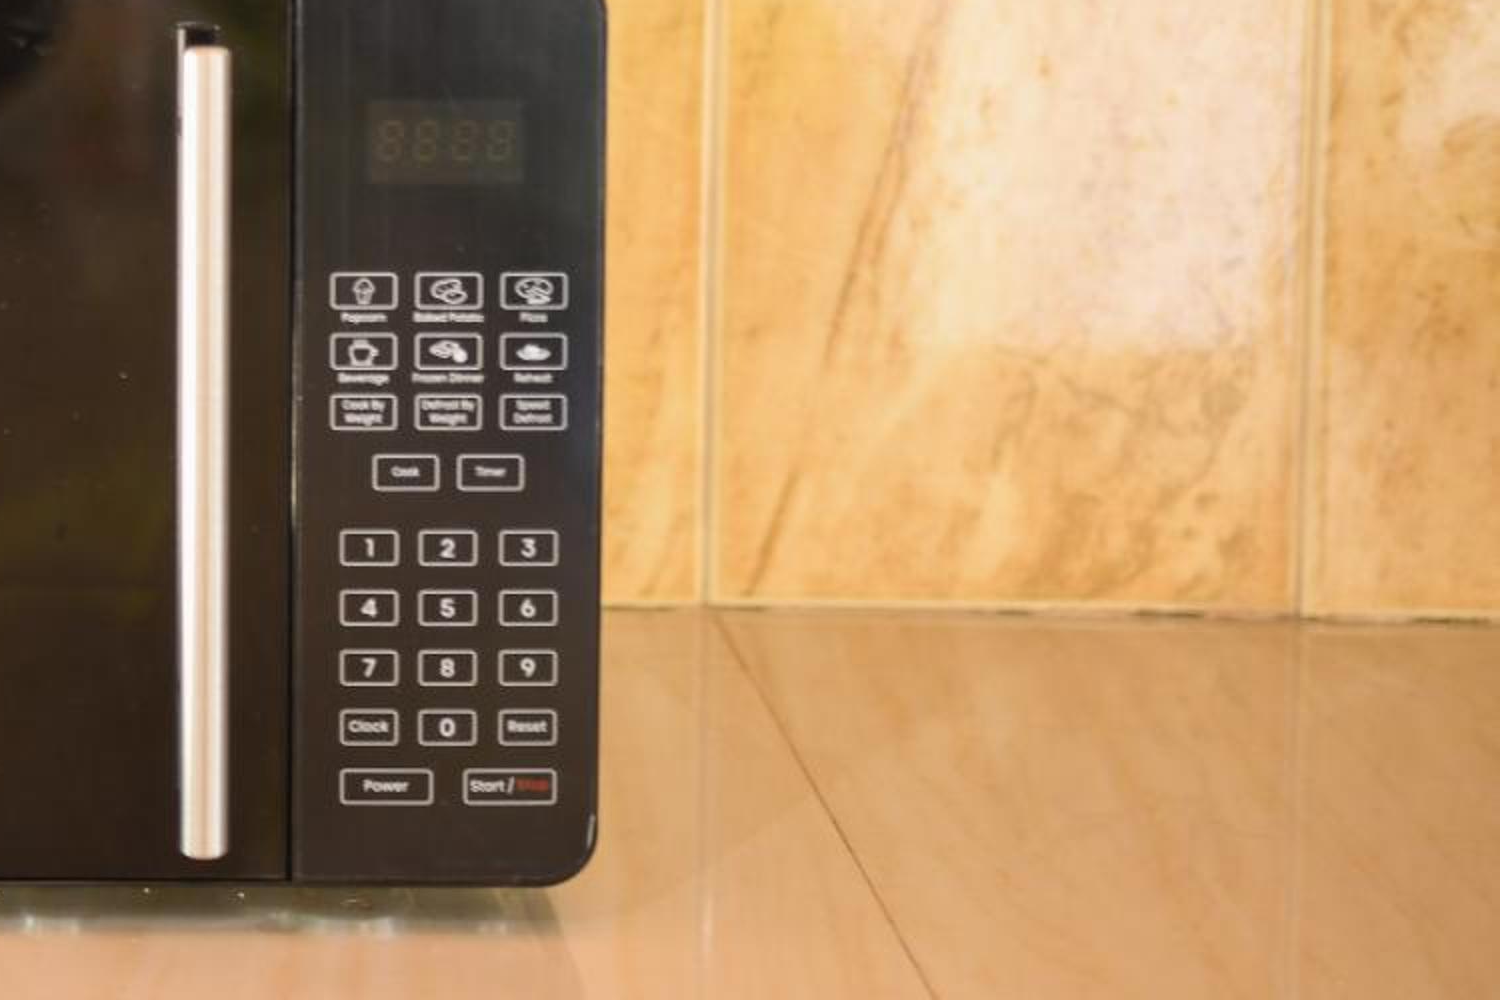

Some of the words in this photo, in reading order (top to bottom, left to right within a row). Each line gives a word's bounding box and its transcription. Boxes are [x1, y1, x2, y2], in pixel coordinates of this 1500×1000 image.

[364, 538, 375, 558] 1
[439, 538, 456, 558] 2
[520, 538, 537, 558] 3
[360, 598, 378, 618] 4
[439, 598, 456, 618] 5
[520, 598, 537, 618] 6
[361, 658, 378, 678] 7
[439, 658, 456, 678] 8
[520, 658, 537, 678] 9
[348, 719, 389, 734] Clock
[438, 718, 456, 738] 0
[507, 719, 548, 734] Reset
[363, 779, 410, 793] Power
[470, 779, 506, 793] Start
